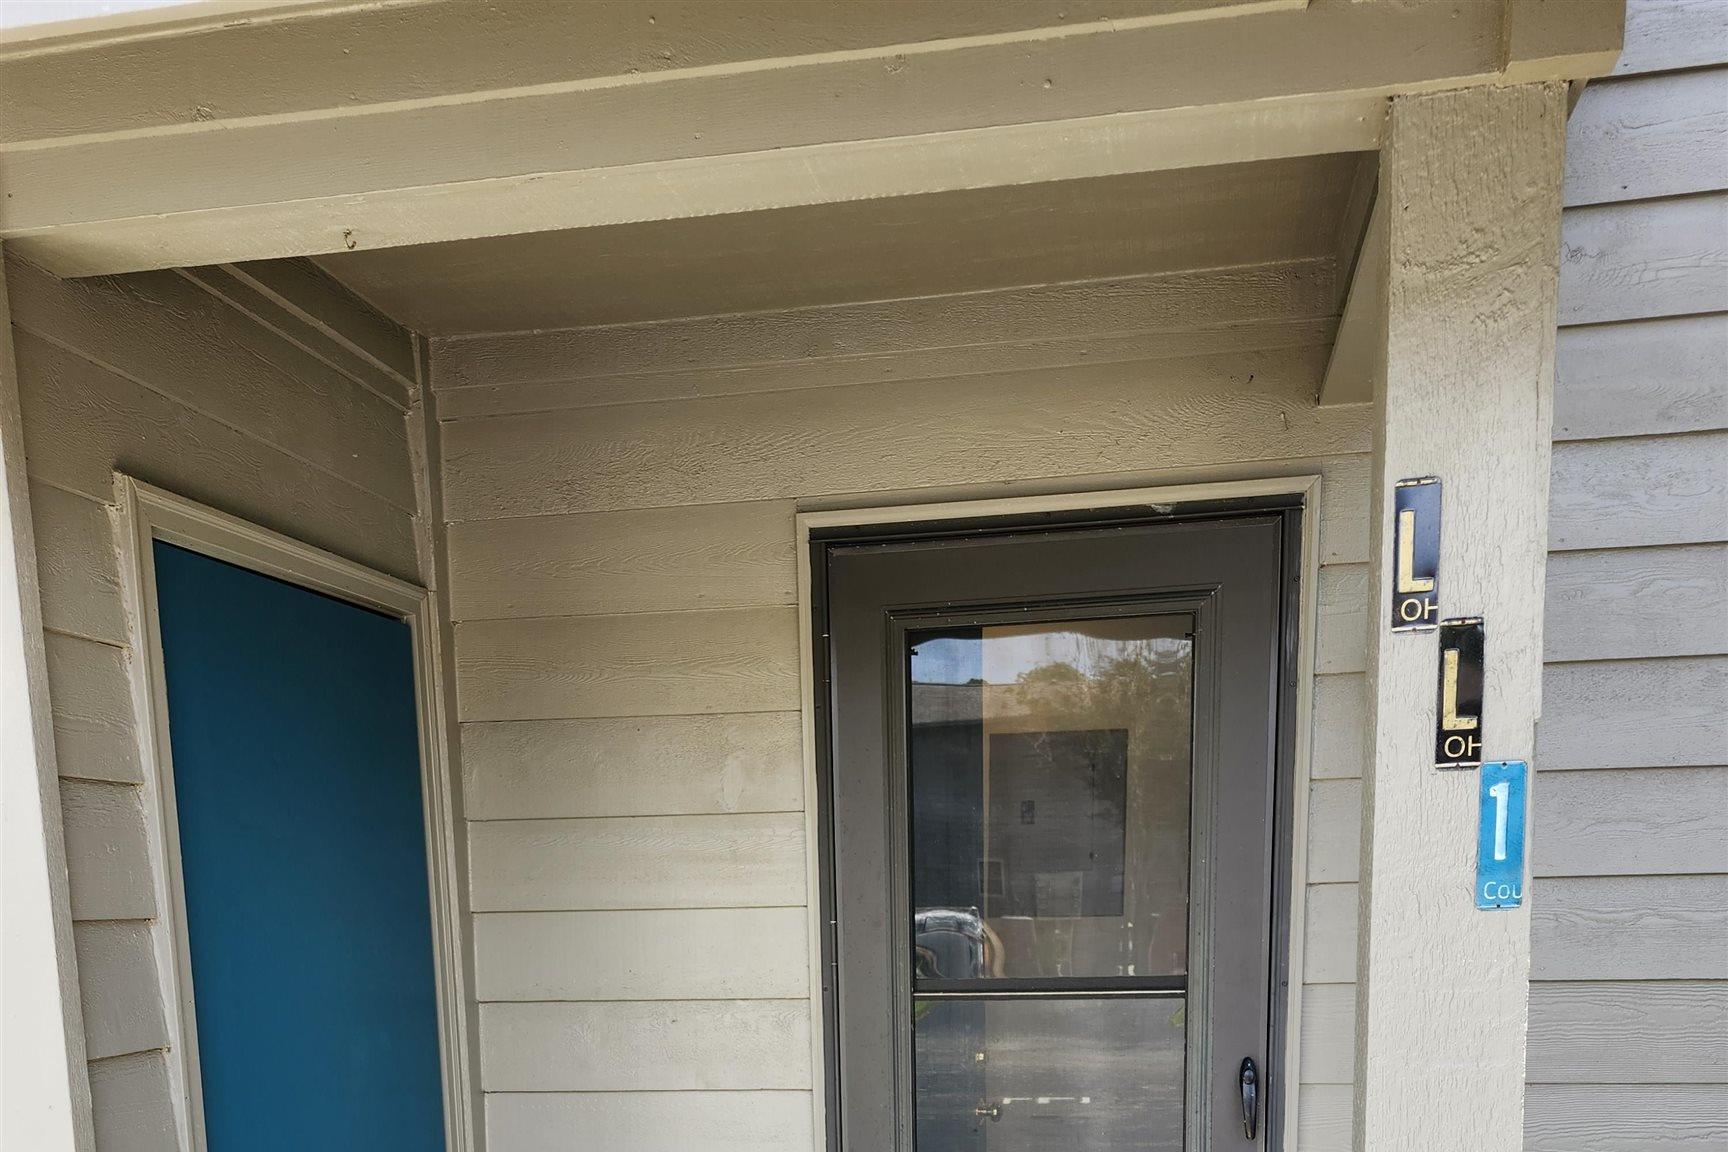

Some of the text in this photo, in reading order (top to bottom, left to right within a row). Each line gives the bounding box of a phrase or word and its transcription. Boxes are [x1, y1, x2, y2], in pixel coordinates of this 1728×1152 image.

[1398, 510, 1434, 594] L
[1442, 648, 1478, 731] L
[1489, 782, 1510, 861] 1
